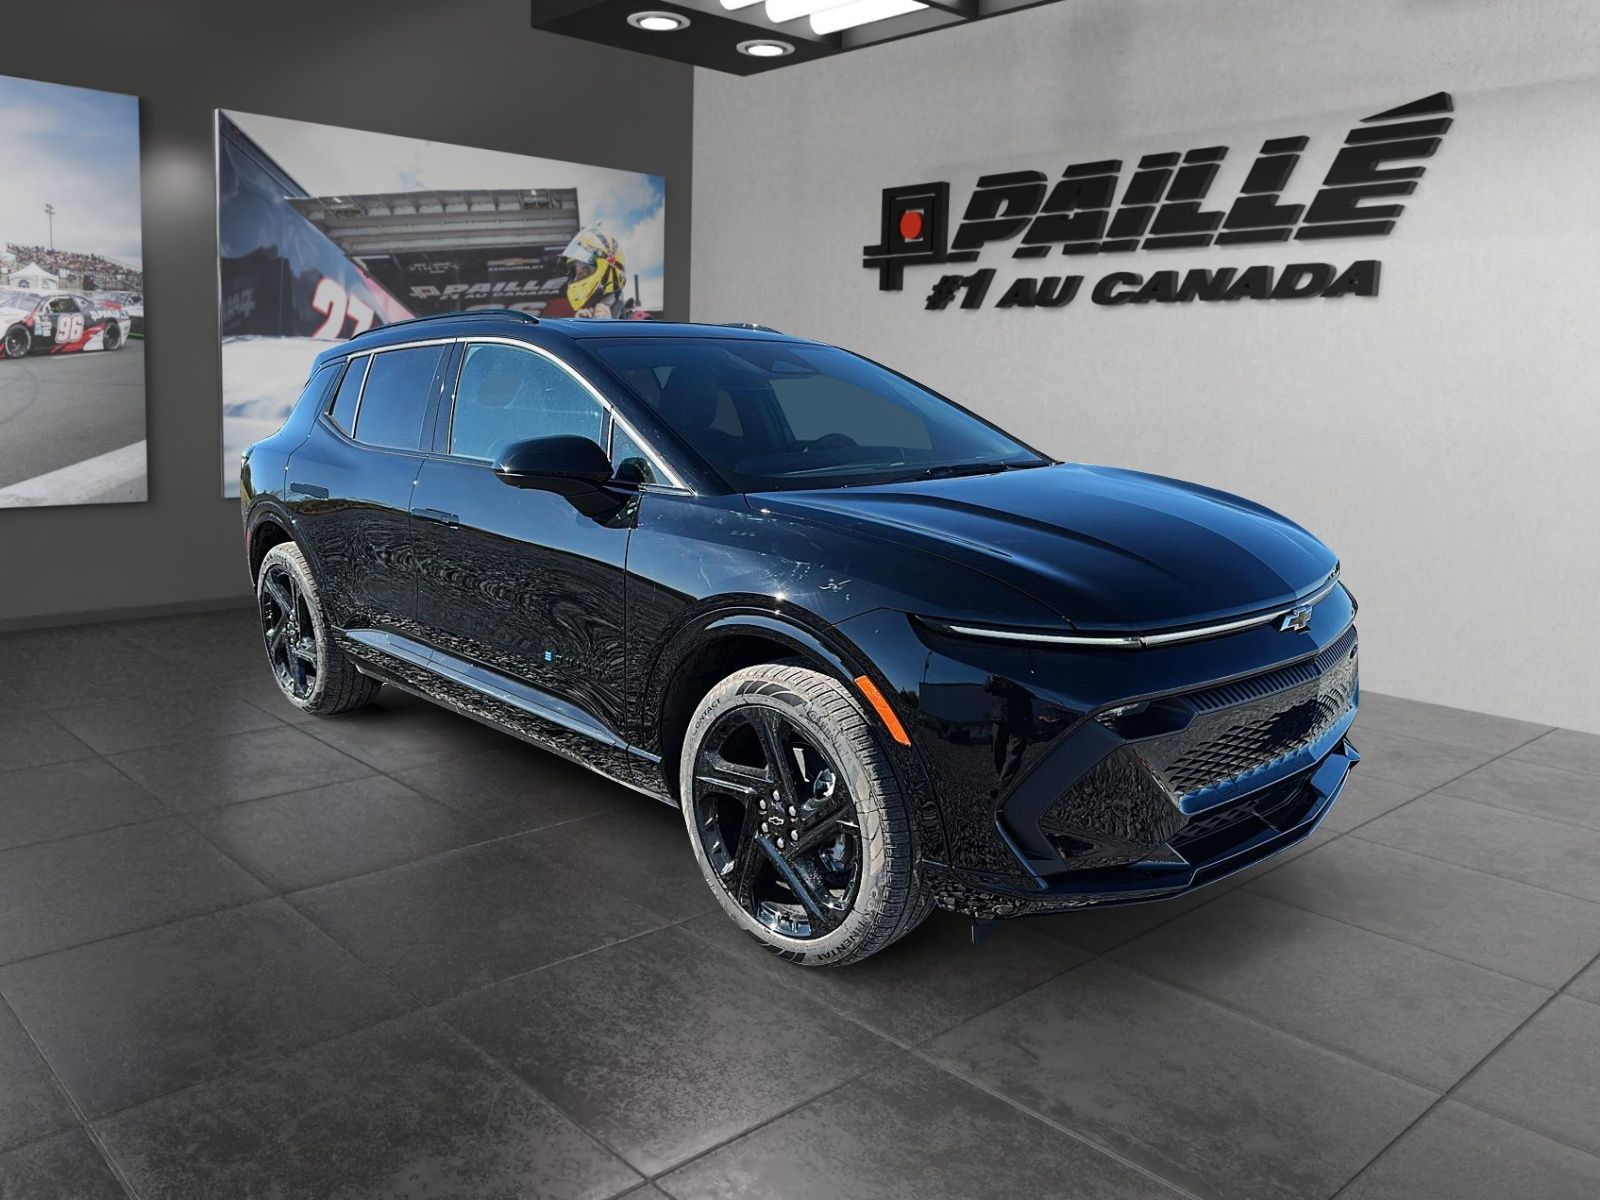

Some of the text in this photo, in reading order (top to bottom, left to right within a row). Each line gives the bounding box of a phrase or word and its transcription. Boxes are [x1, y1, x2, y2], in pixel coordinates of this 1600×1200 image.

[947, 91, 1454, 262] PAILLÉ
[492, 289, 560, 297] CANADA
[925, 260, 1382, 311] #1 AU CANADA
[55, 312, 85, 344] 96
